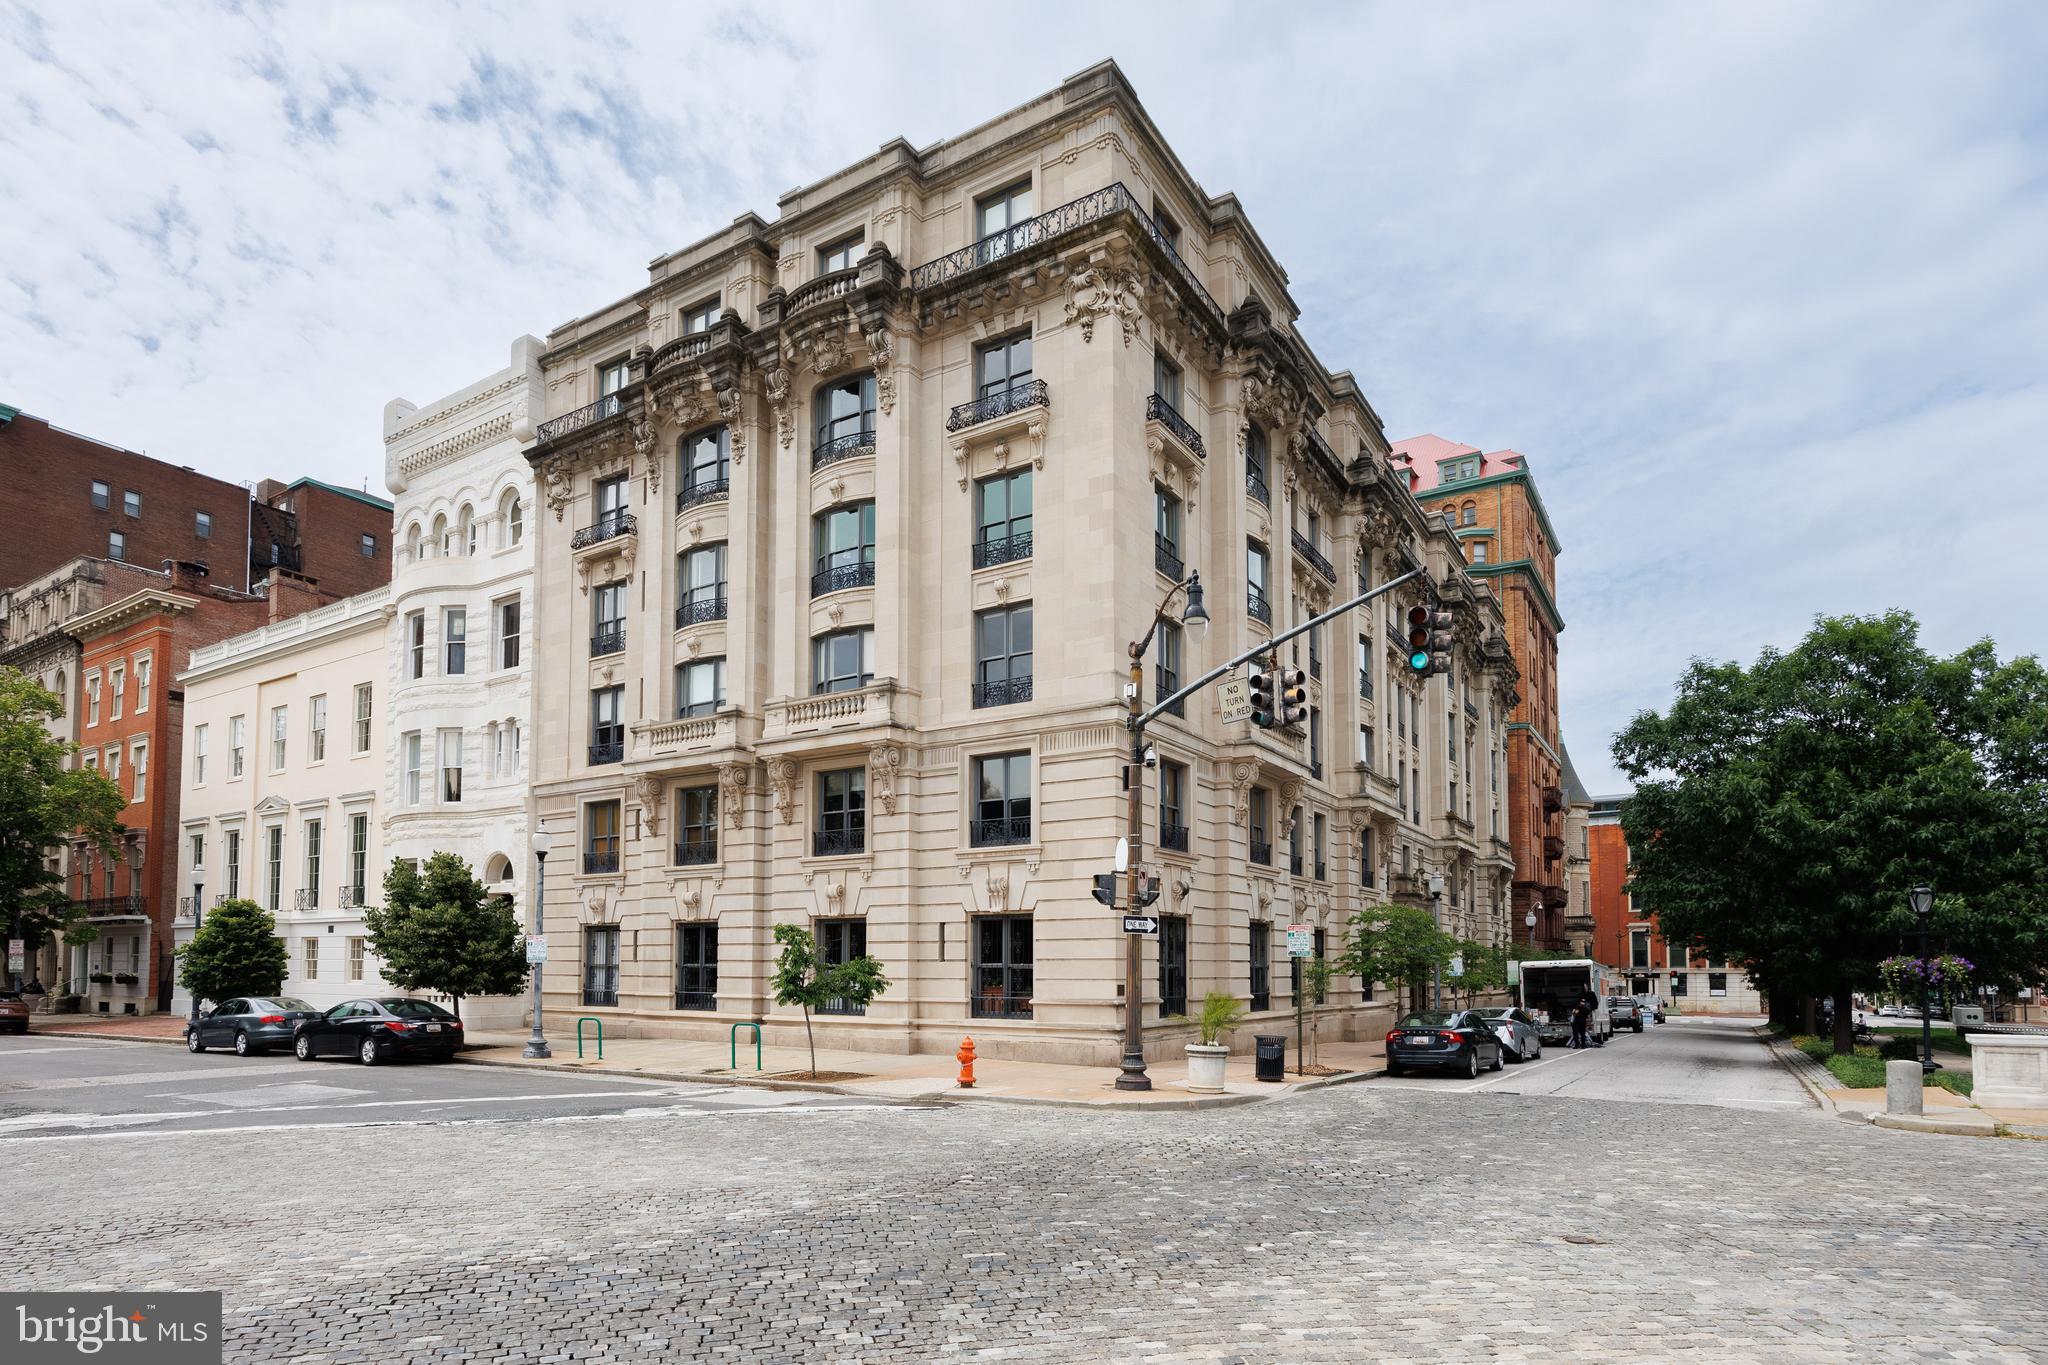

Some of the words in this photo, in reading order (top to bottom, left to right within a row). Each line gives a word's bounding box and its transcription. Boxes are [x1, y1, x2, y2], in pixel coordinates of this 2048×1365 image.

[1227, 685, 1239, 695] NO
[1225, 696, 1244, 707] TURN
[1223, 710, 1232, 719] ON
[1237, 705, 1250, 716] RED
[1127, 920, 1137, 929] ONE
[1138, 921, 1148, 929] WAY
